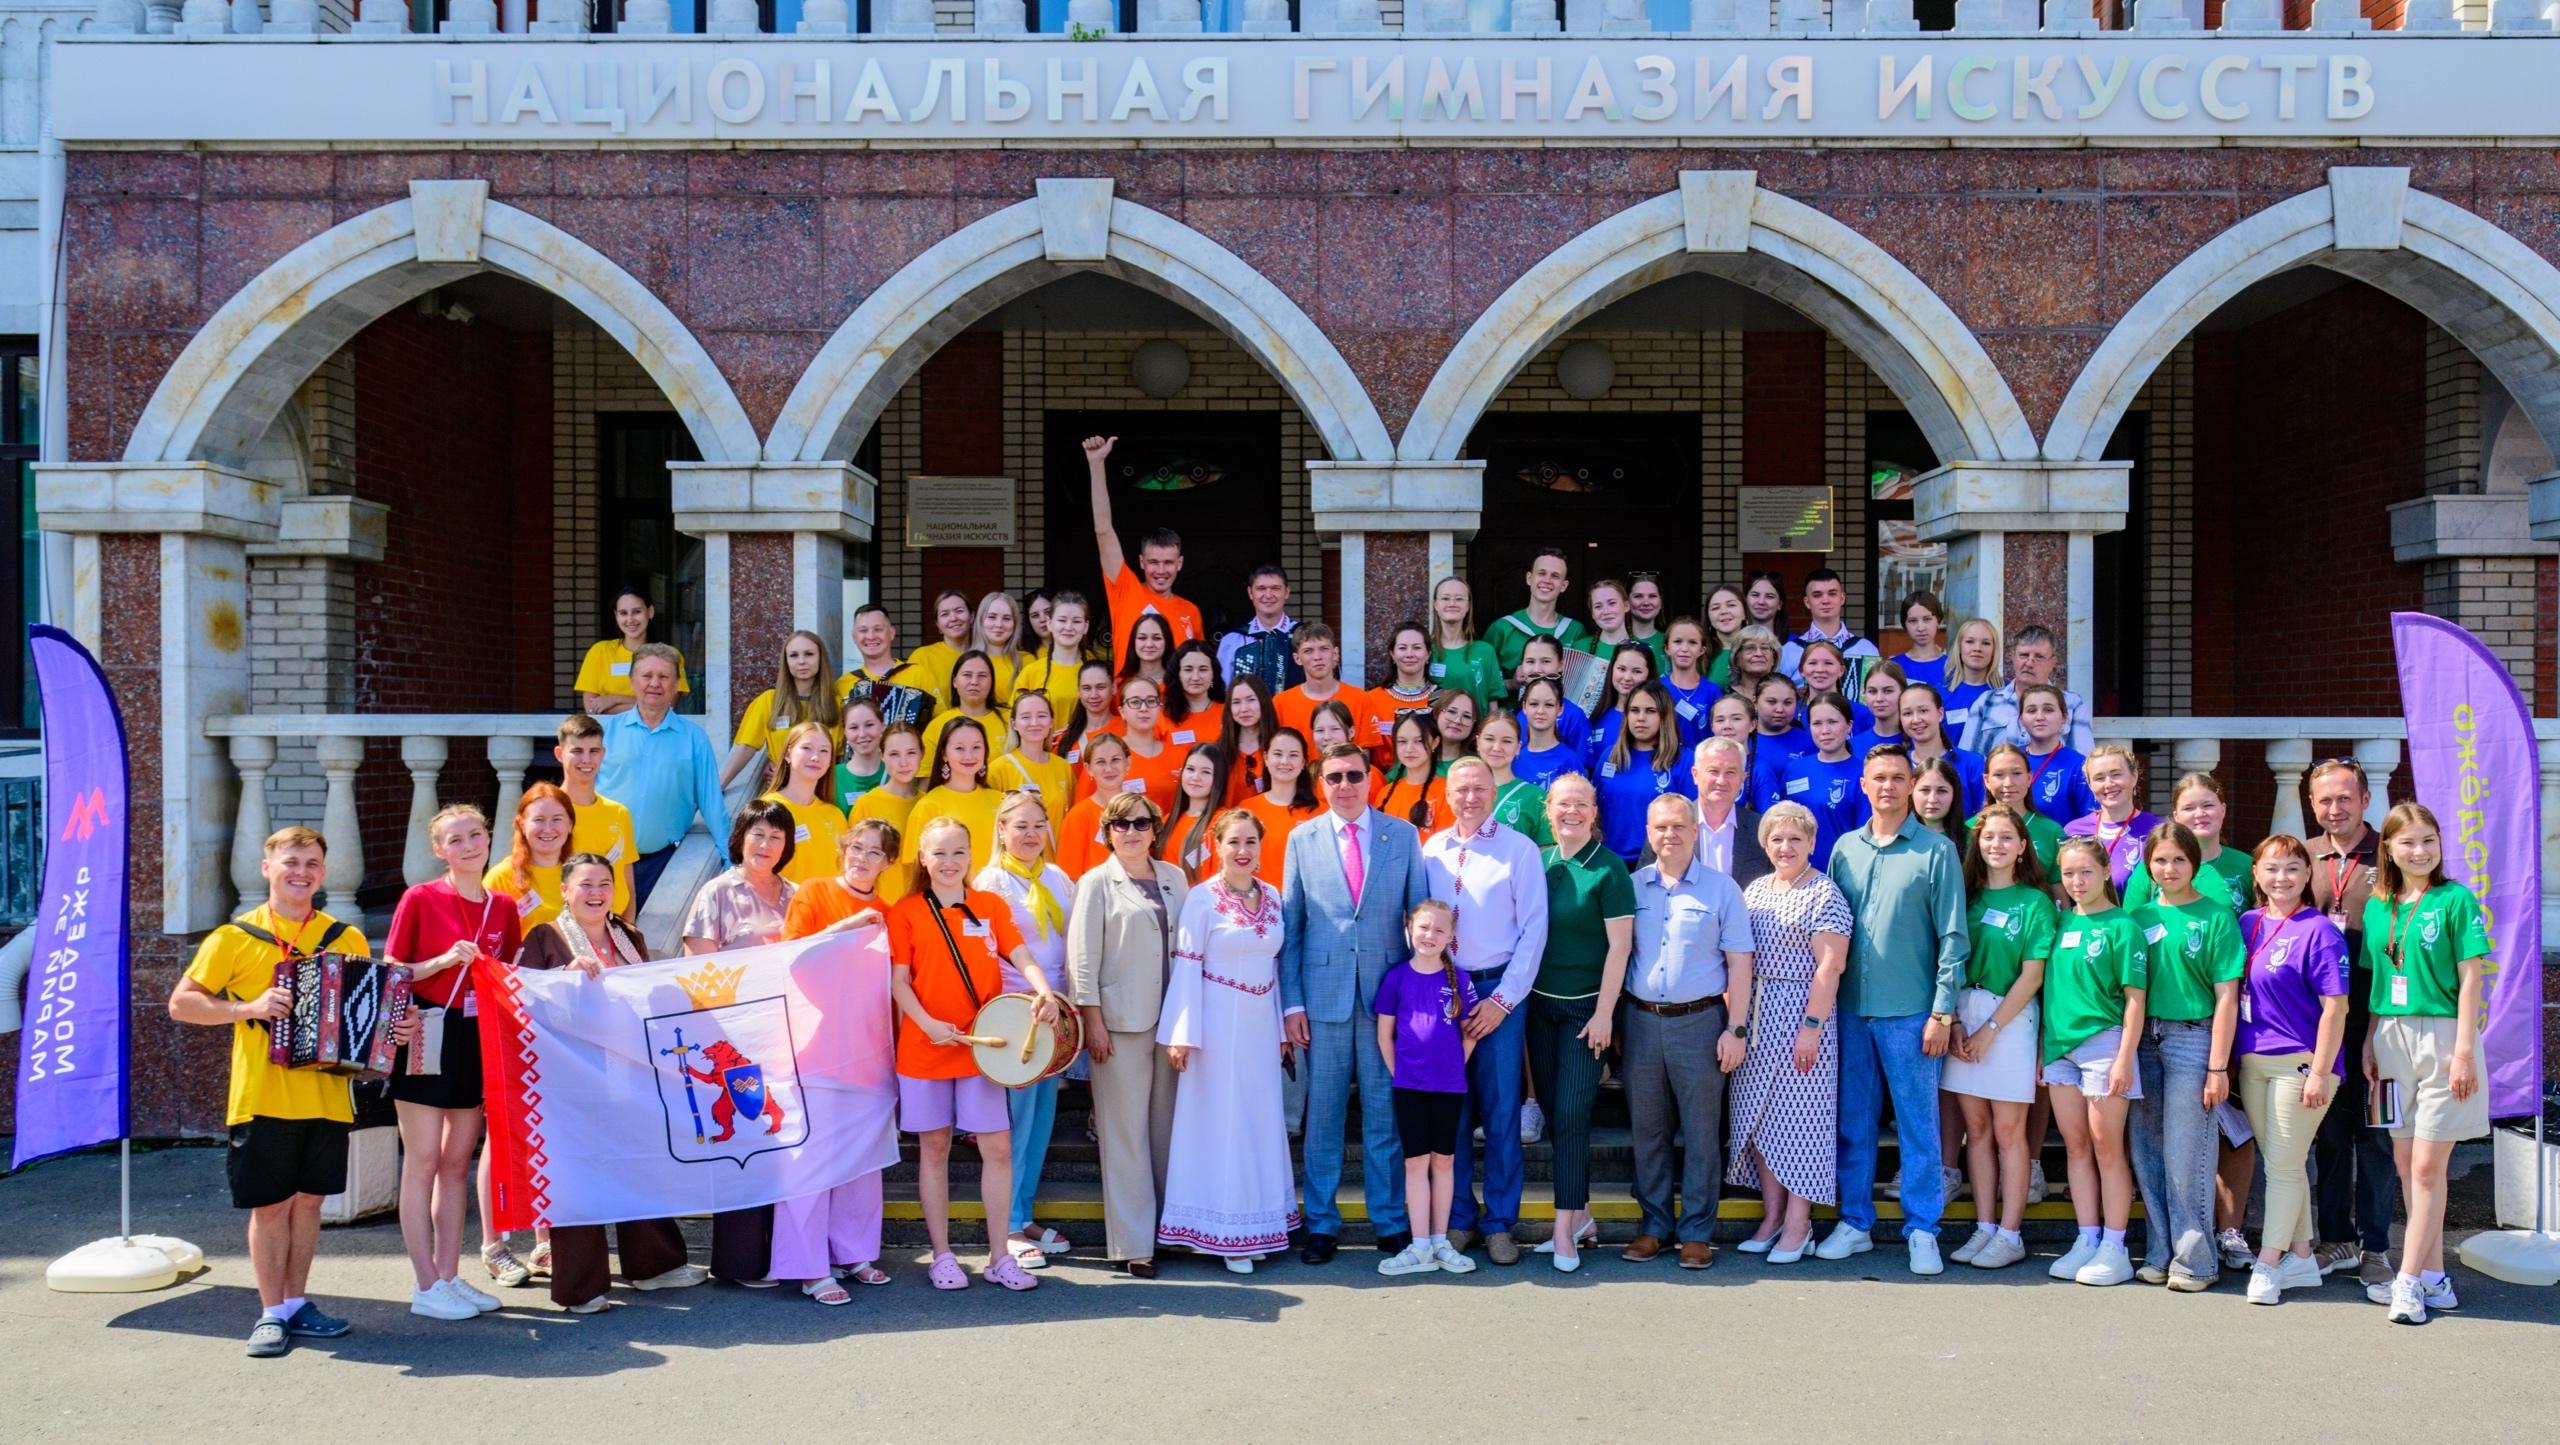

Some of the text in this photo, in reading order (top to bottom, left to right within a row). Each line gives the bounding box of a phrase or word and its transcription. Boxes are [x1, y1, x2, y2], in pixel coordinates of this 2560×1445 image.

[433, 53, 2376, 133] НАЦИОНАЛЬНАЯ ГИМНАЗИЯ ИСКУССТВ
[926, 522, 998, 531] НАЦИОНАЛЬНАЯ
[963, 532, 1009, 541] ИСКУССТВ
